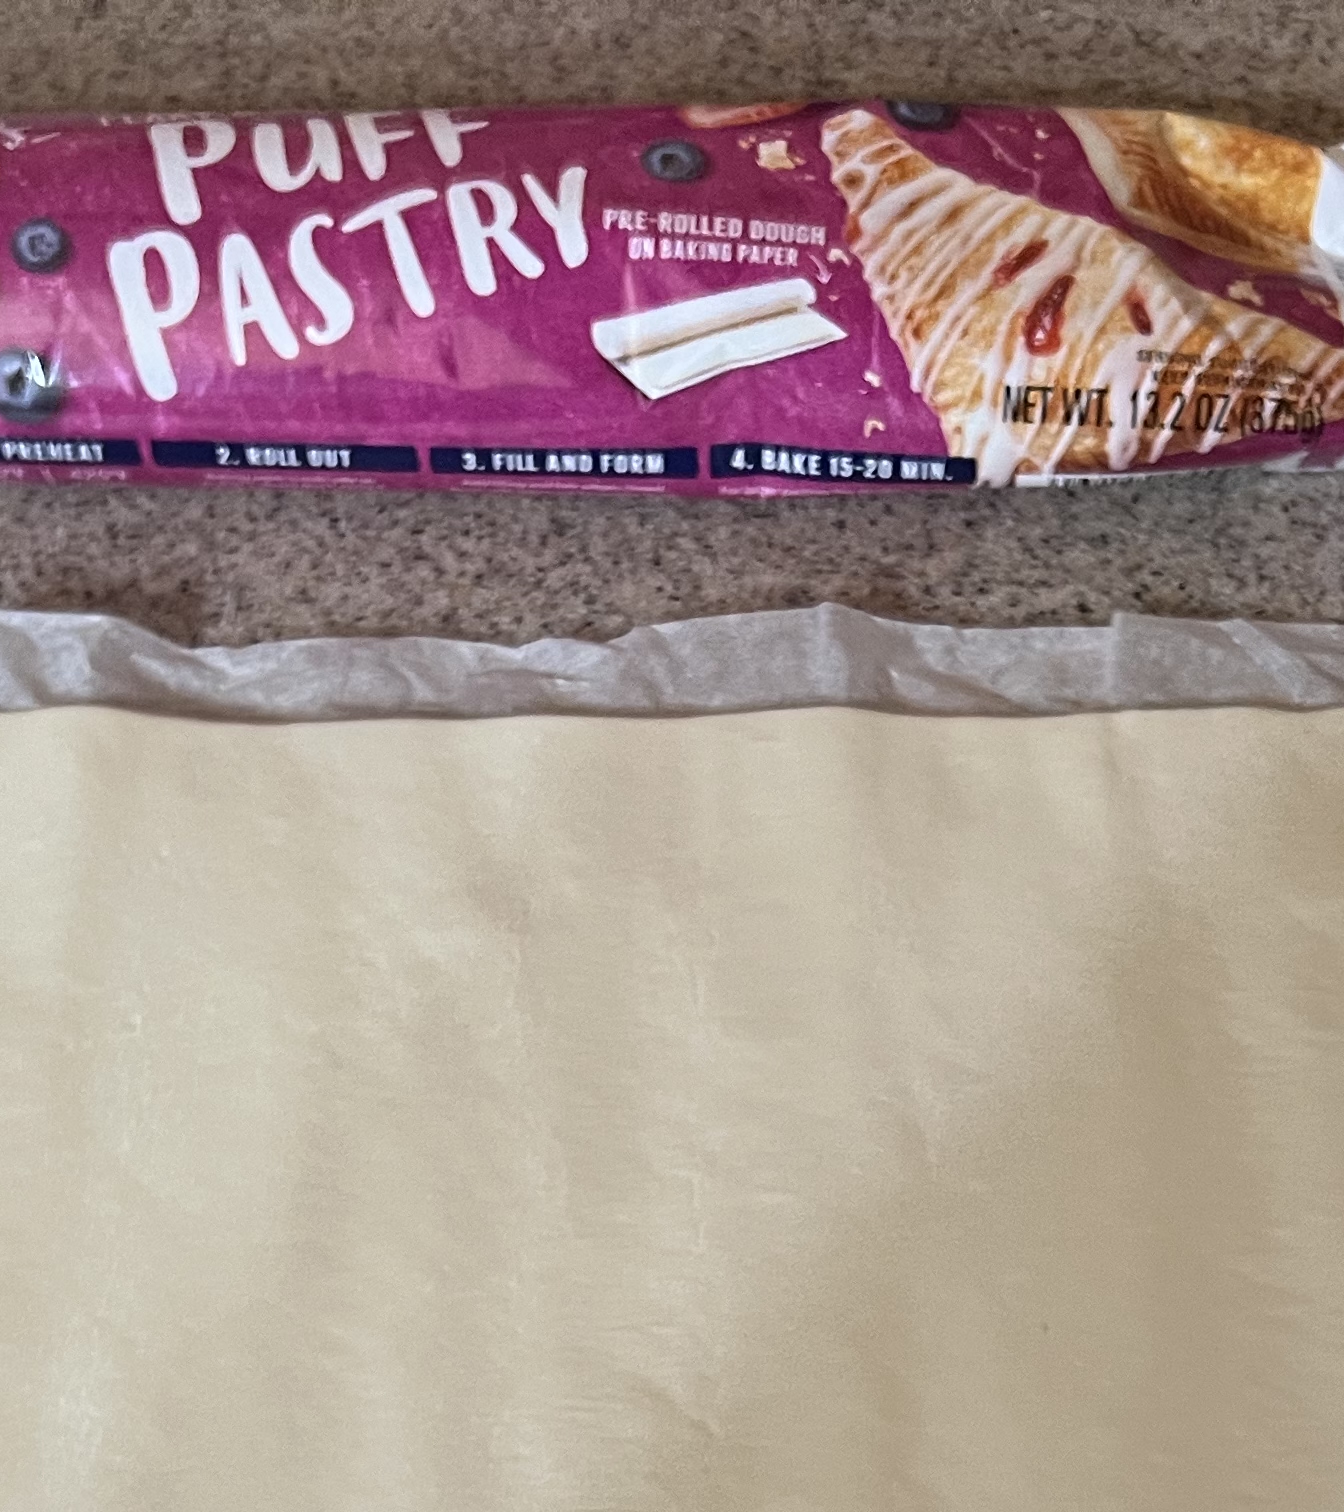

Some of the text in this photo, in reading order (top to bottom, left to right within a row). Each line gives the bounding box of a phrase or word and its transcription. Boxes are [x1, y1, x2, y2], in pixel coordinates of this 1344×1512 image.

[150, 110, 490, 226] PUFF
[602, 208, 827, 247] PRE-ROLLED DOUGH
[628, 236, 799, 267] ON BAKING PAPER
[108, 166, 589, 402] PASTRY
[1004, 385, 1053, 425] NET
[1061, 388, 1115, 428] WT.
[1193, 393, 1230, 433] OZ
[0, 442, 104, 463] PREHEAT
[214, 442, 351, 469] 2. ROLL OUT
[461, 451, 665, 474] 3. FILL AND FORM
[730, 446, 954, 482] 4. BAKE 15-20 MIN.
